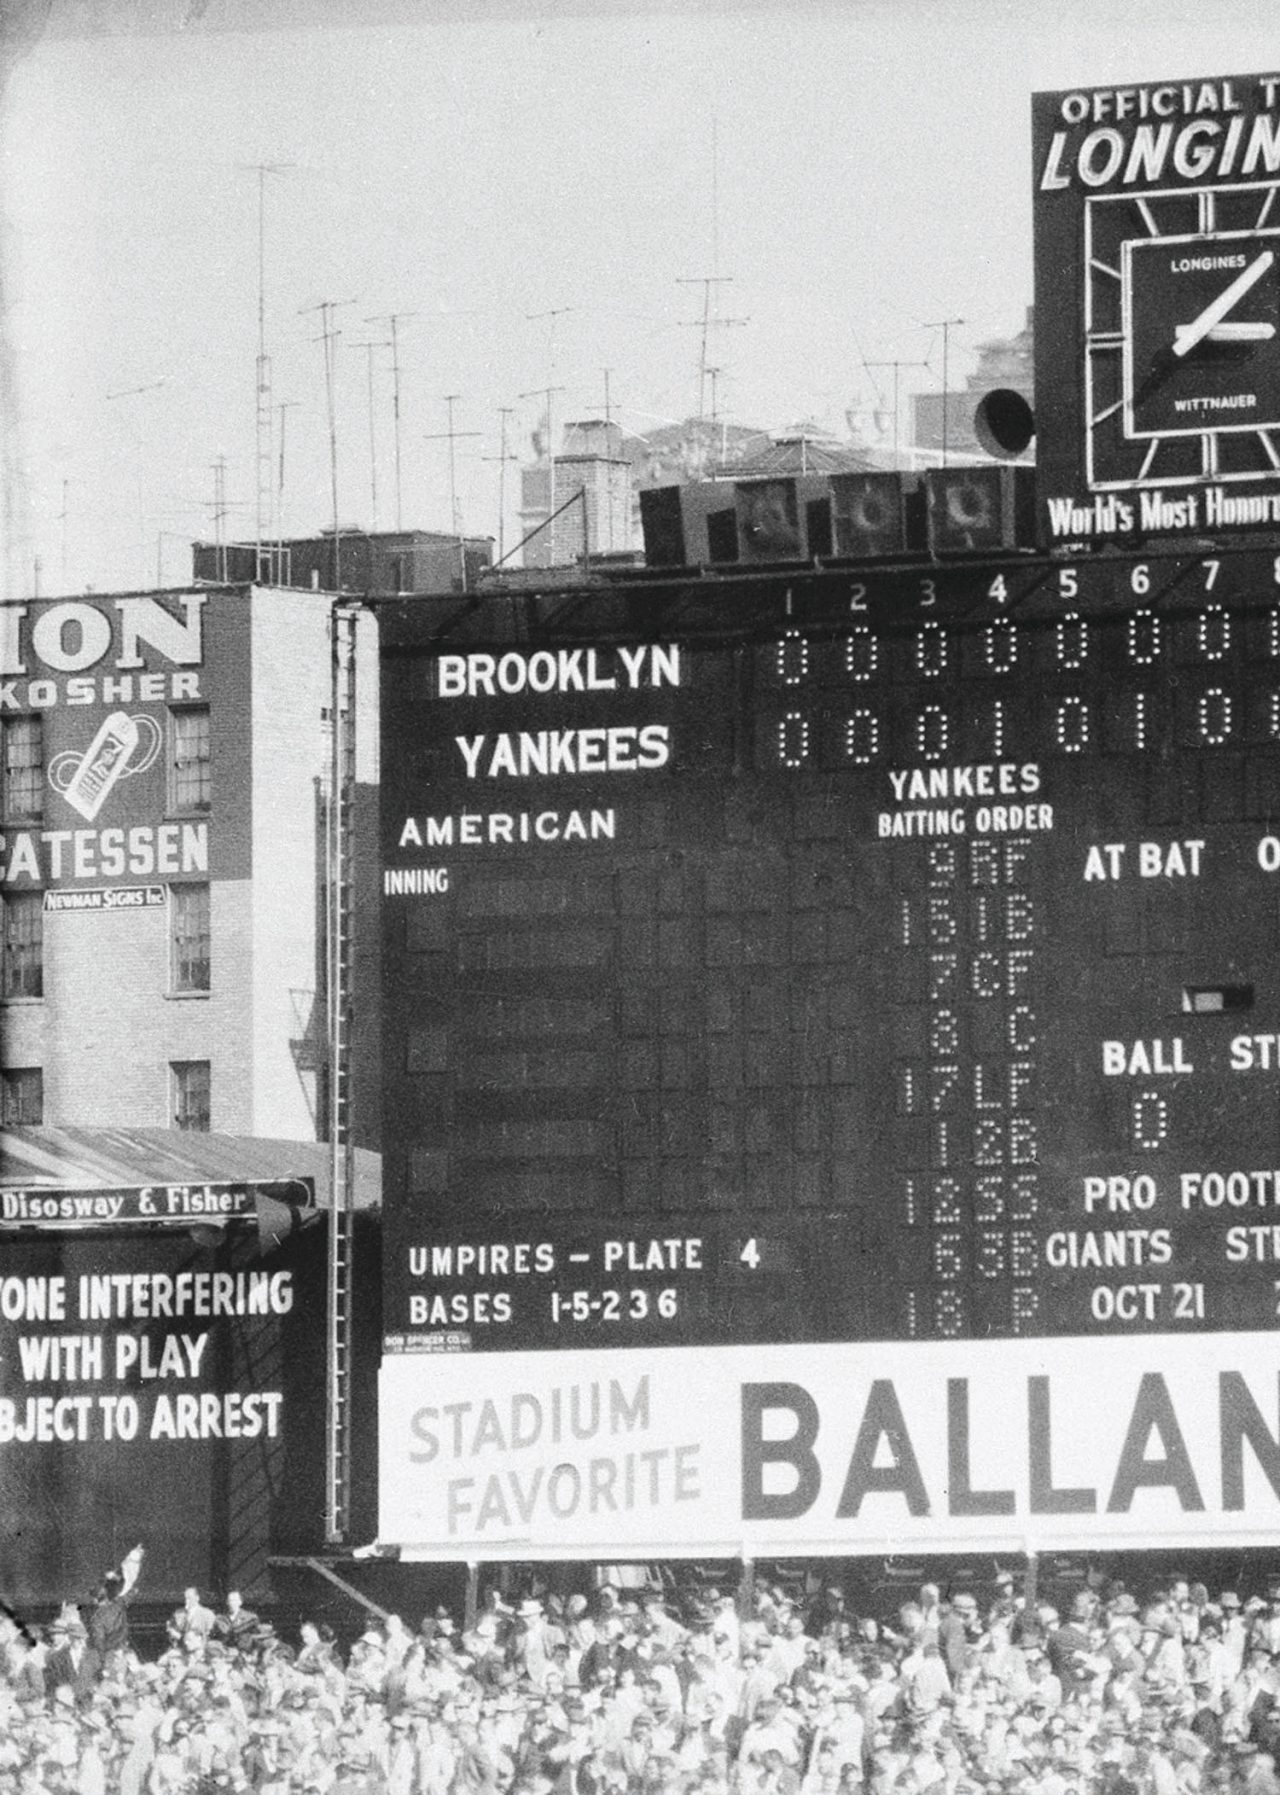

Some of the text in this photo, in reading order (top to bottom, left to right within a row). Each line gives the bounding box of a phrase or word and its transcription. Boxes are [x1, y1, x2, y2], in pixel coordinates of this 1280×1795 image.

[1060, 80, 1241, 124] OFFICIAL
[1170, 253, 1247, 273] LONGINES
[1175, 395, 1256, 411] WITTNAUER
[1047, 493, 1134, 536] World's
[1136, 485, 1197, 529] Most
[850, 583, 868, 611] 2
[920, 579, 937, 606] 3
[989, 575, 1007, 602] 4
[1060, 569, 1077, 597] 5
[1132, 565, 1149, 593] 6
[1203, 561, 1219, 590] 7
[778, 631, 809, 684] 0
[847, 627, 878, 680] 0
[918, 622, 948, 676] 0
[986, 617, 1018, 672] 0
[1056, 612, 1088, 669] 0
[1128, 609, 1160, 664] 0
[1199, 603, 1231, 660] 0
[0, 672, 202, 709] KOSHER
[439, 645, 679, 697] BROOKLYN
[778, 712, 809, 767] 0
[847, 709, 878, 763] 0
[918, 704, 949, 760] 0
[994, 701, 1002, 757] 1
[1057, 697, 1089, 753] 0
[1136, 693, 1145, 749] 1
[1200, 688, 1232, 744] 0
[456, 726, 668, 777] YANKEES
[890, 764, 1039, 800] YANKEES
[400, 809, 614, 846] AMERICAN
[879, 805, 1052, 837] BATTING ORDER
[0, 823, 208, 882] ATESSEN
[971, 839, 1032, 884] RF
[1085, 841, 1204, 881] AT BAT
[385, 869, 448, 894] INNING
[979, 894, 1034, 940] 1B
[931, 950, 1034, 999] 7 CF
[1008, 1005, 1036, 1051] C
[1103, 1038, 1193, 1075] BALL
[905, 1061, 1035, 1112] 17 LF
[975, 1118, 1037, 1166] 2B
[1134, 1091, 1167, 1149] 0
[2, 1182, 246, 1220] Disosway & Fisher
[975, 1174, 1038, 1222] SS
[1084, 1175, 1156, 1212] PRO
[410, 1244, 554, 1275] UMPIRES
[605, 1239, 702, 1271] PLATE
[741, 1239, 760, 1268] 4
[934, 1231, 1039, 1280] 6 3B
[1047, 1230, 1171, 1267] GIANTS
[0, 1272, 292, 1322] ONE INTERFERING
[411, 1293, 511, 1324] BASES
[1012, 1287, 1038, 1333] P
[1092, 1282, 1206, 1320] OCT 21
[19, 1334, 207, 1381] WITH PLAY
[99, 1396, 138, 1440] TO
[150, 1393, 282, 1439] ARREST
[409, 1374, 652, 1464] STADIUM
[448, 1443, 701, 1535] FAVORITE
